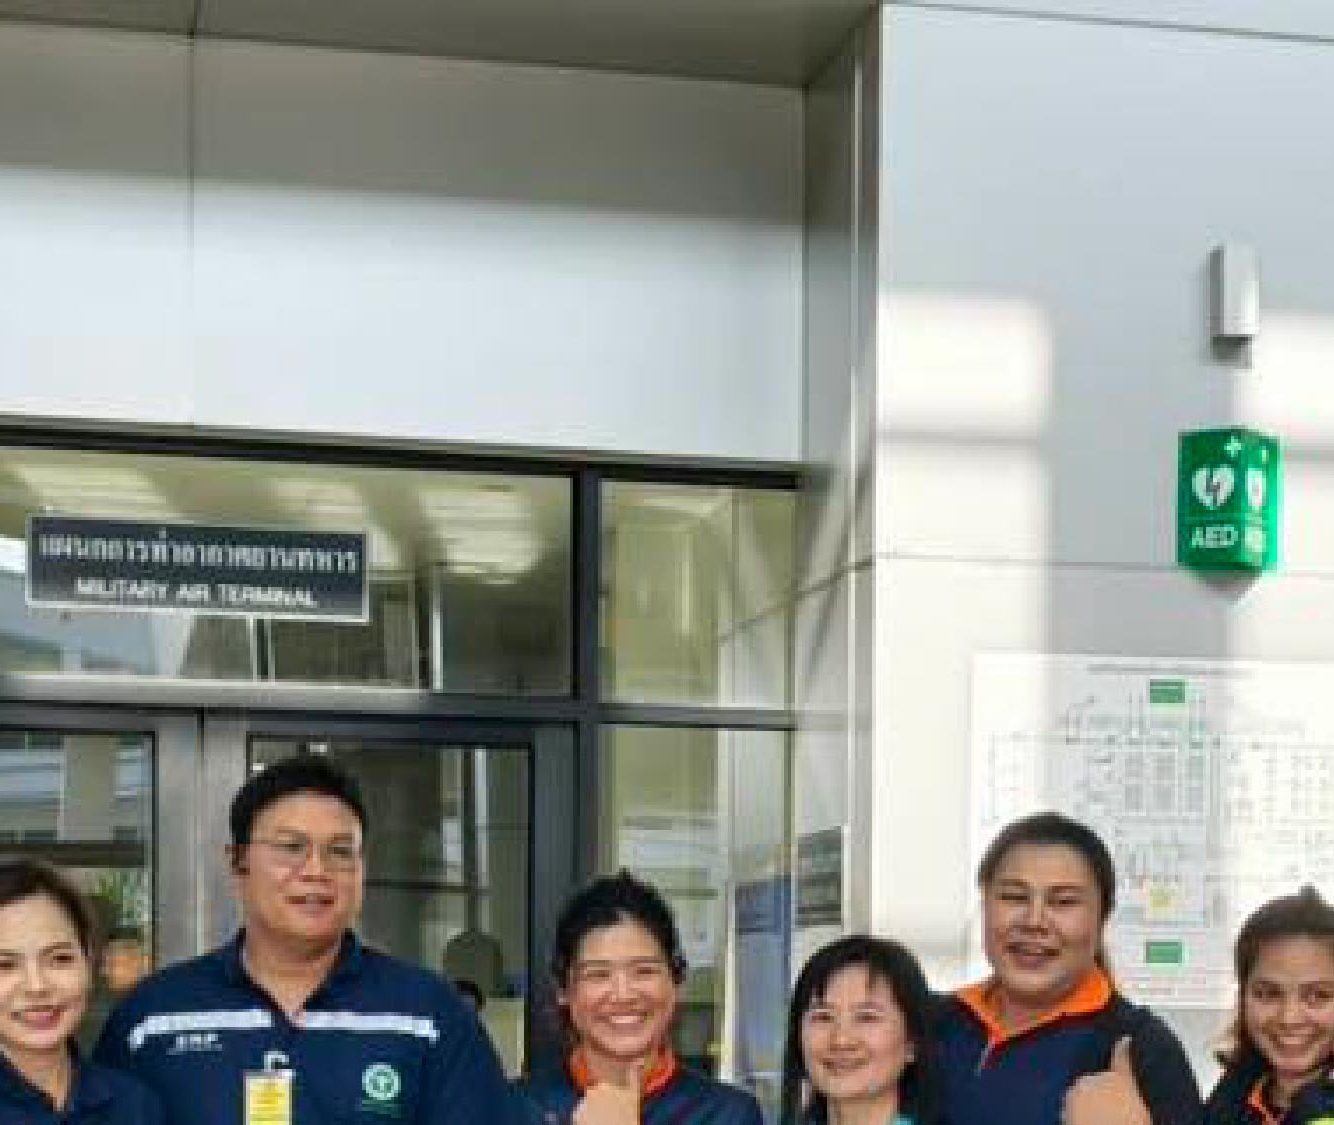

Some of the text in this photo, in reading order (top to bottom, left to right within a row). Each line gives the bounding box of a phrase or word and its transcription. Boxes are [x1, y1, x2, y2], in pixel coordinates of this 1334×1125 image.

[1189, 524, 1239, 549] AED
[76, 577, 316, 606] MILITARY AIR TERMINAL
